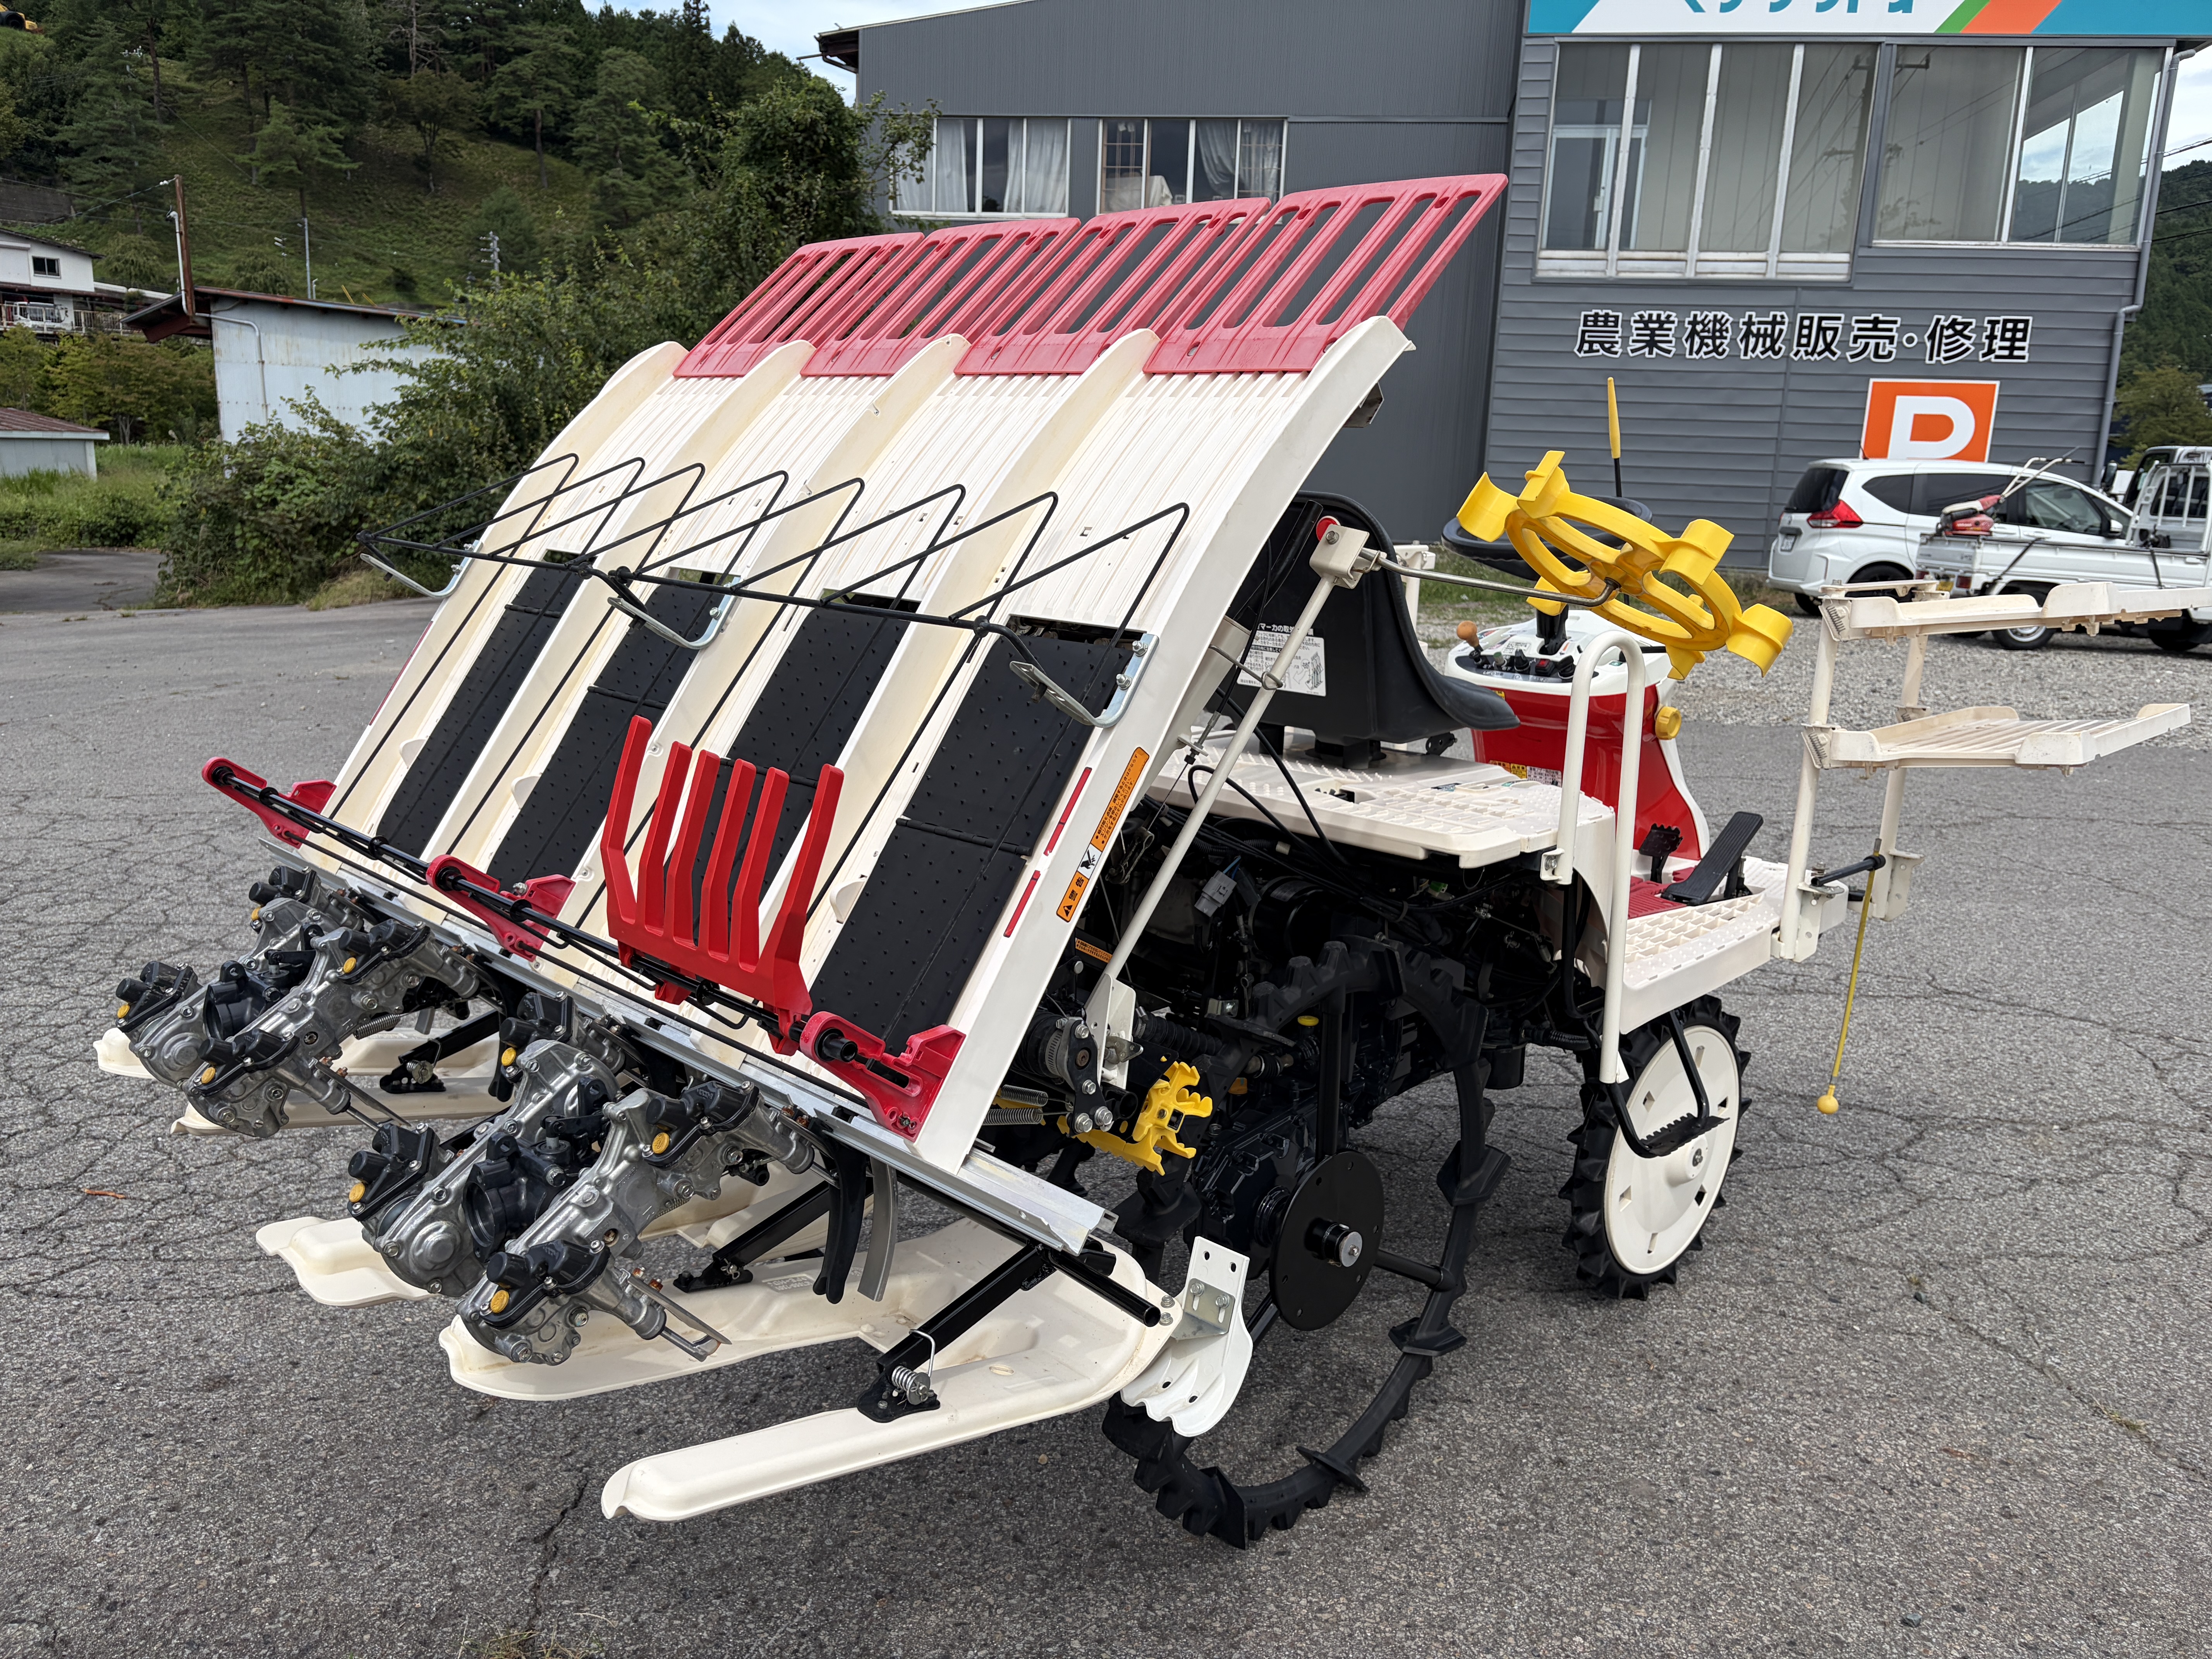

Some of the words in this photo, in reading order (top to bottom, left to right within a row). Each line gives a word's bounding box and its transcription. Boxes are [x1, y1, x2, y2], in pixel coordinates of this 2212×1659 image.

[1574, 310, 2033, 364] 農業機械販売・修理
[1887, 395, 1975, 459] P
